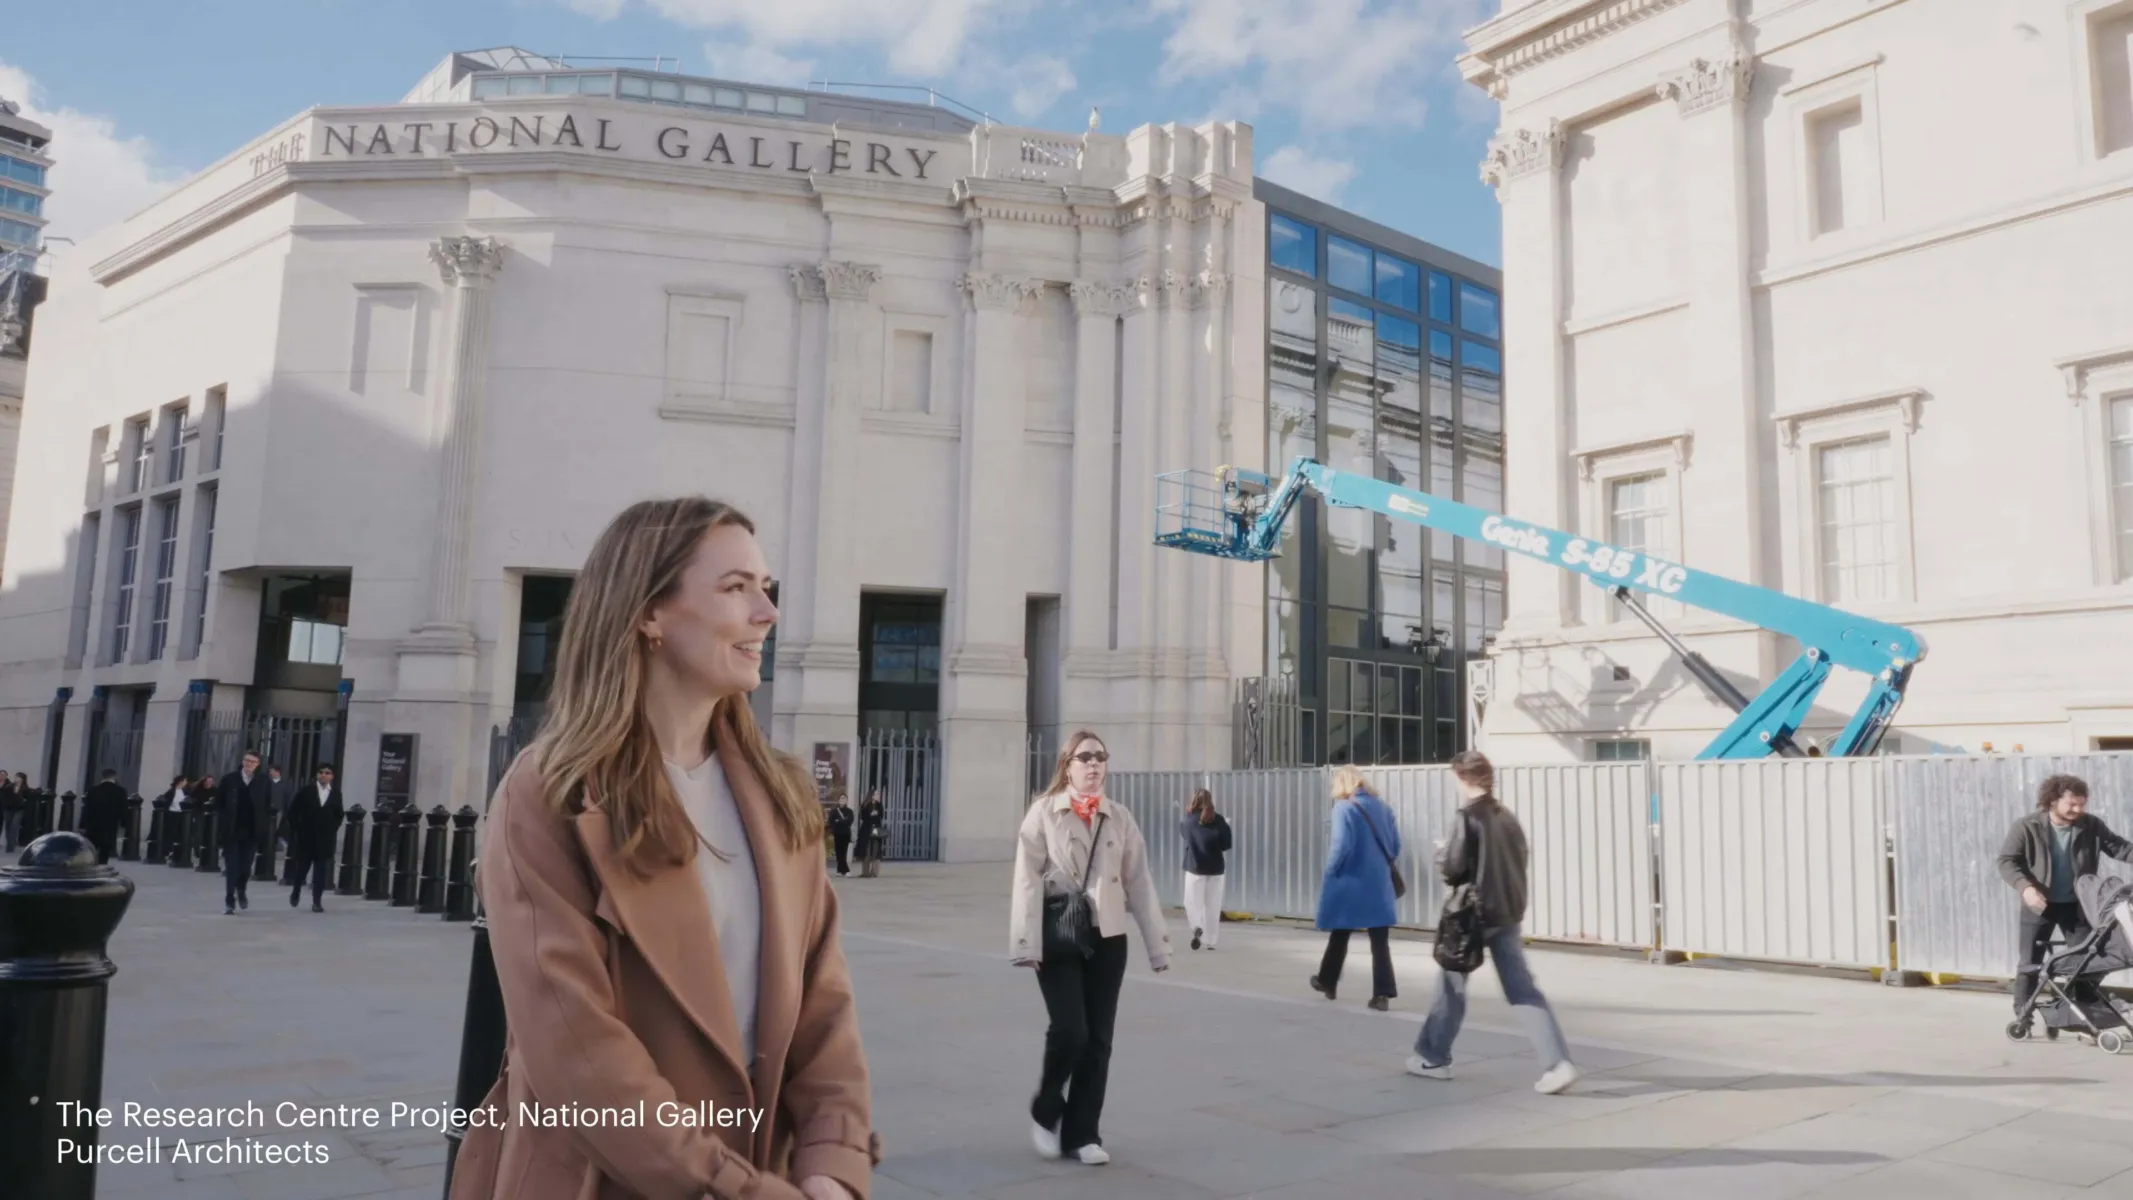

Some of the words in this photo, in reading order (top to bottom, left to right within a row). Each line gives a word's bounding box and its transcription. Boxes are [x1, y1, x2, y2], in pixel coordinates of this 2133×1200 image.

[321, 114, 622, 155] NATIONAL
[657, 127, 938, 179] GALLERY
[1481, 516, 1549, 557] Genie
[1561, 538, 1636, 578] S-85
[1634, 557, 1687, 593] XC
